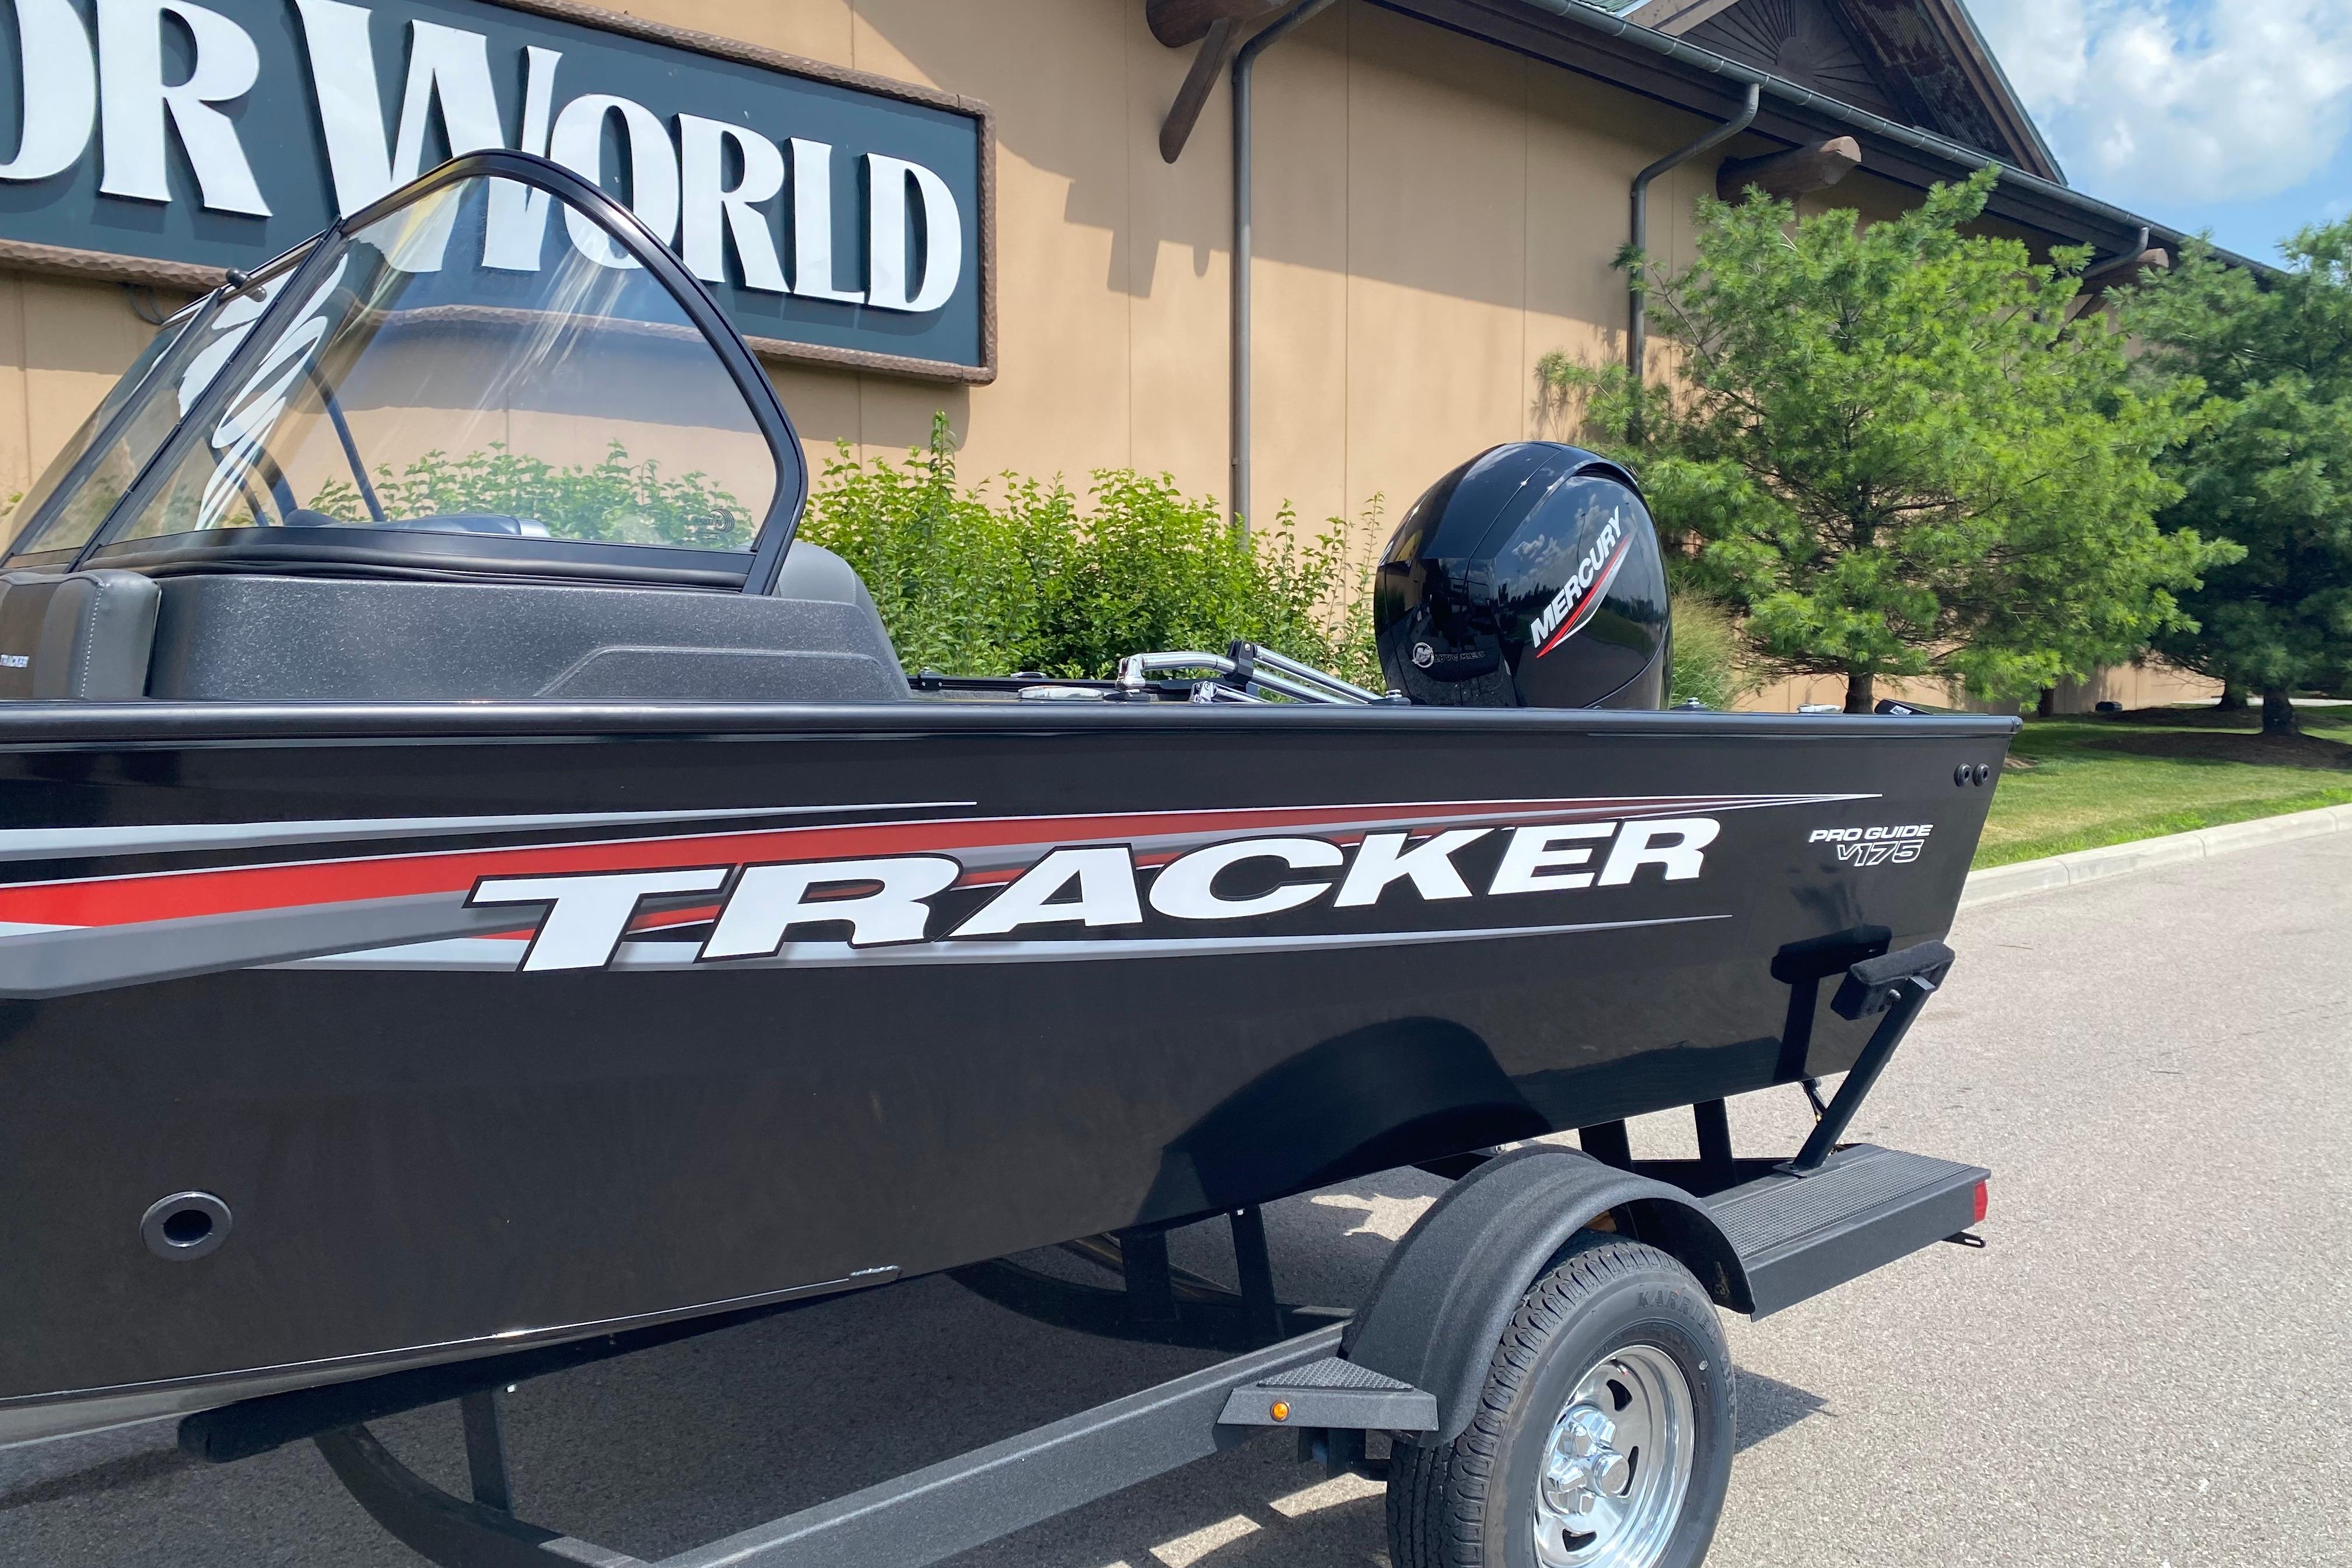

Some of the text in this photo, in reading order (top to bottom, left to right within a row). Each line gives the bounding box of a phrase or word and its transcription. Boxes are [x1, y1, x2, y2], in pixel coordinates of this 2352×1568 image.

[295, 0, 962, 313] WORLD
[1530, 505, 1621, 648] MERCURY
[470, 817, 1722, 972] TRACKER
[1809, 824, 1934, 843] PRO GUIDE
[1636, 1289, 1718, 1345] KARRIER
